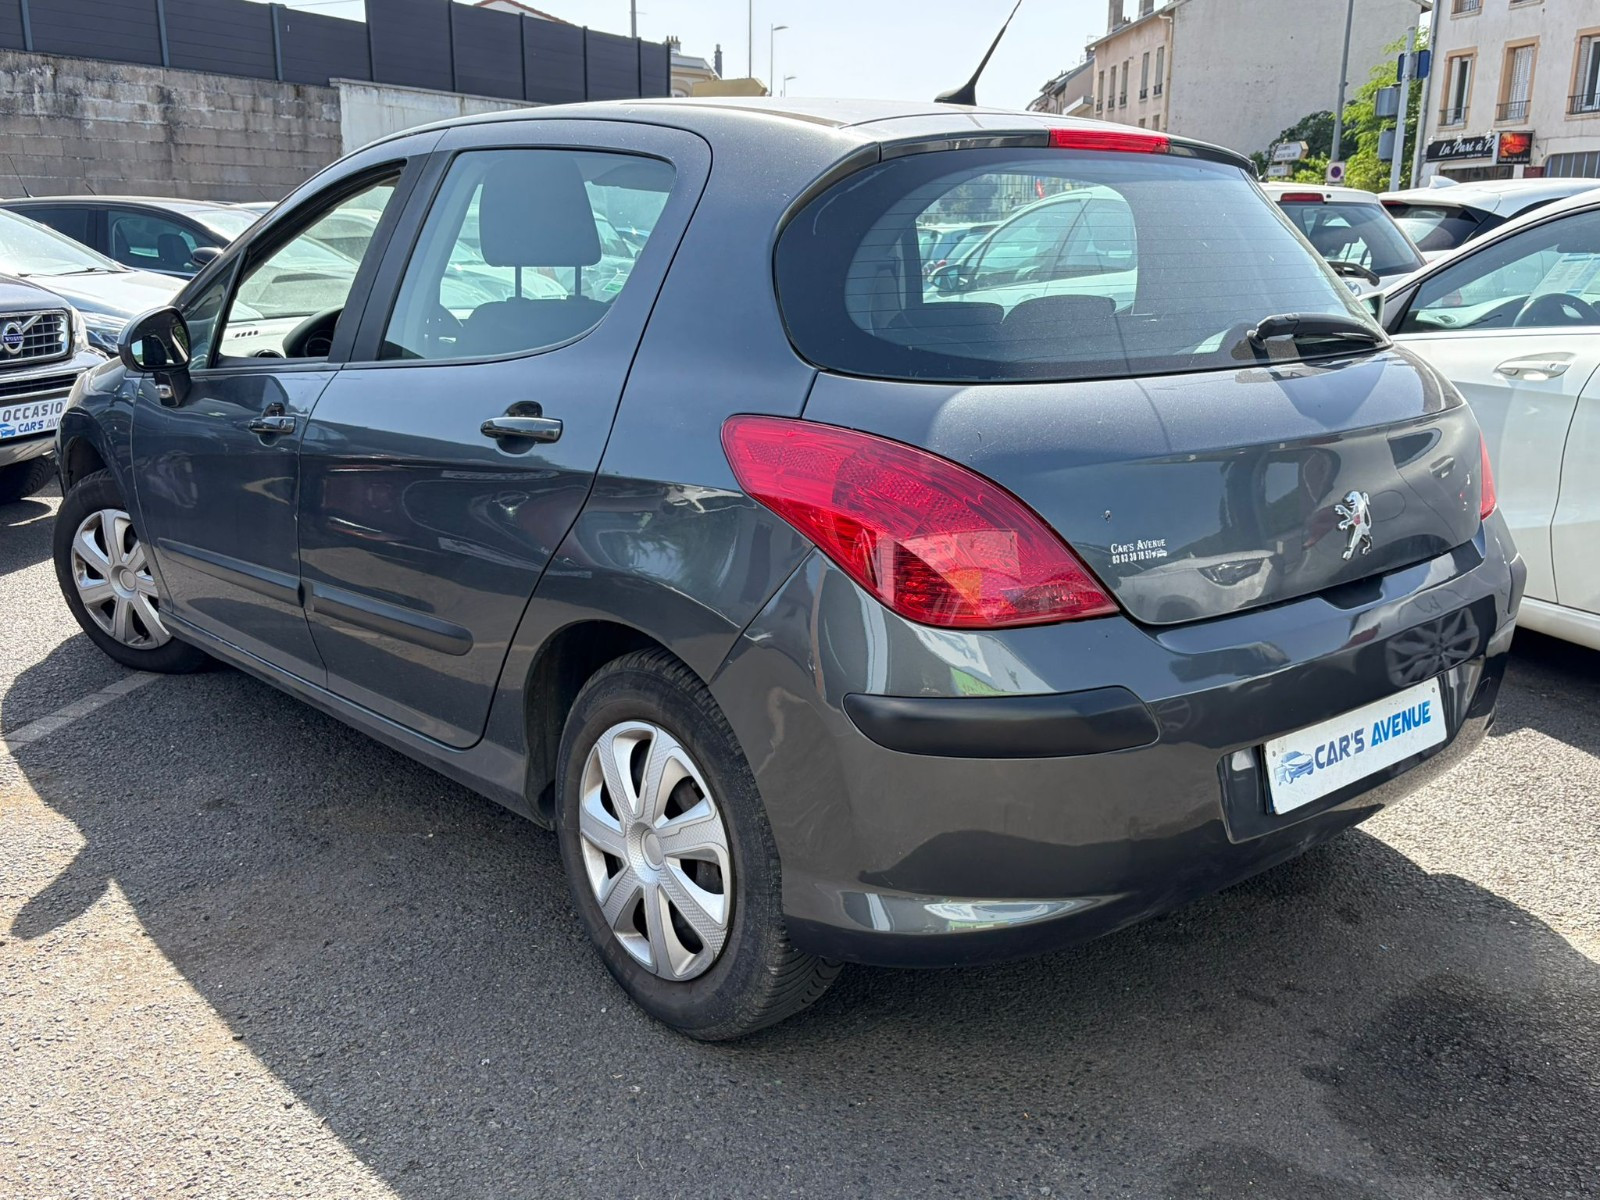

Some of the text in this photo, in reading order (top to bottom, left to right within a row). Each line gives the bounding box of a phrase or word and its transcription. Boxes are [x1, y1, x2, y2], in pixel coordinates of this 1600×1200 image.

[1438, 142, 1451, 156] La
[1452, 140, 1473, 154] Part
[1475, 140, 1483, 151] à
[18, 420, 44, 433] CAR'S
[1314, 700, 1431, 769] CAR'S AVENUE
